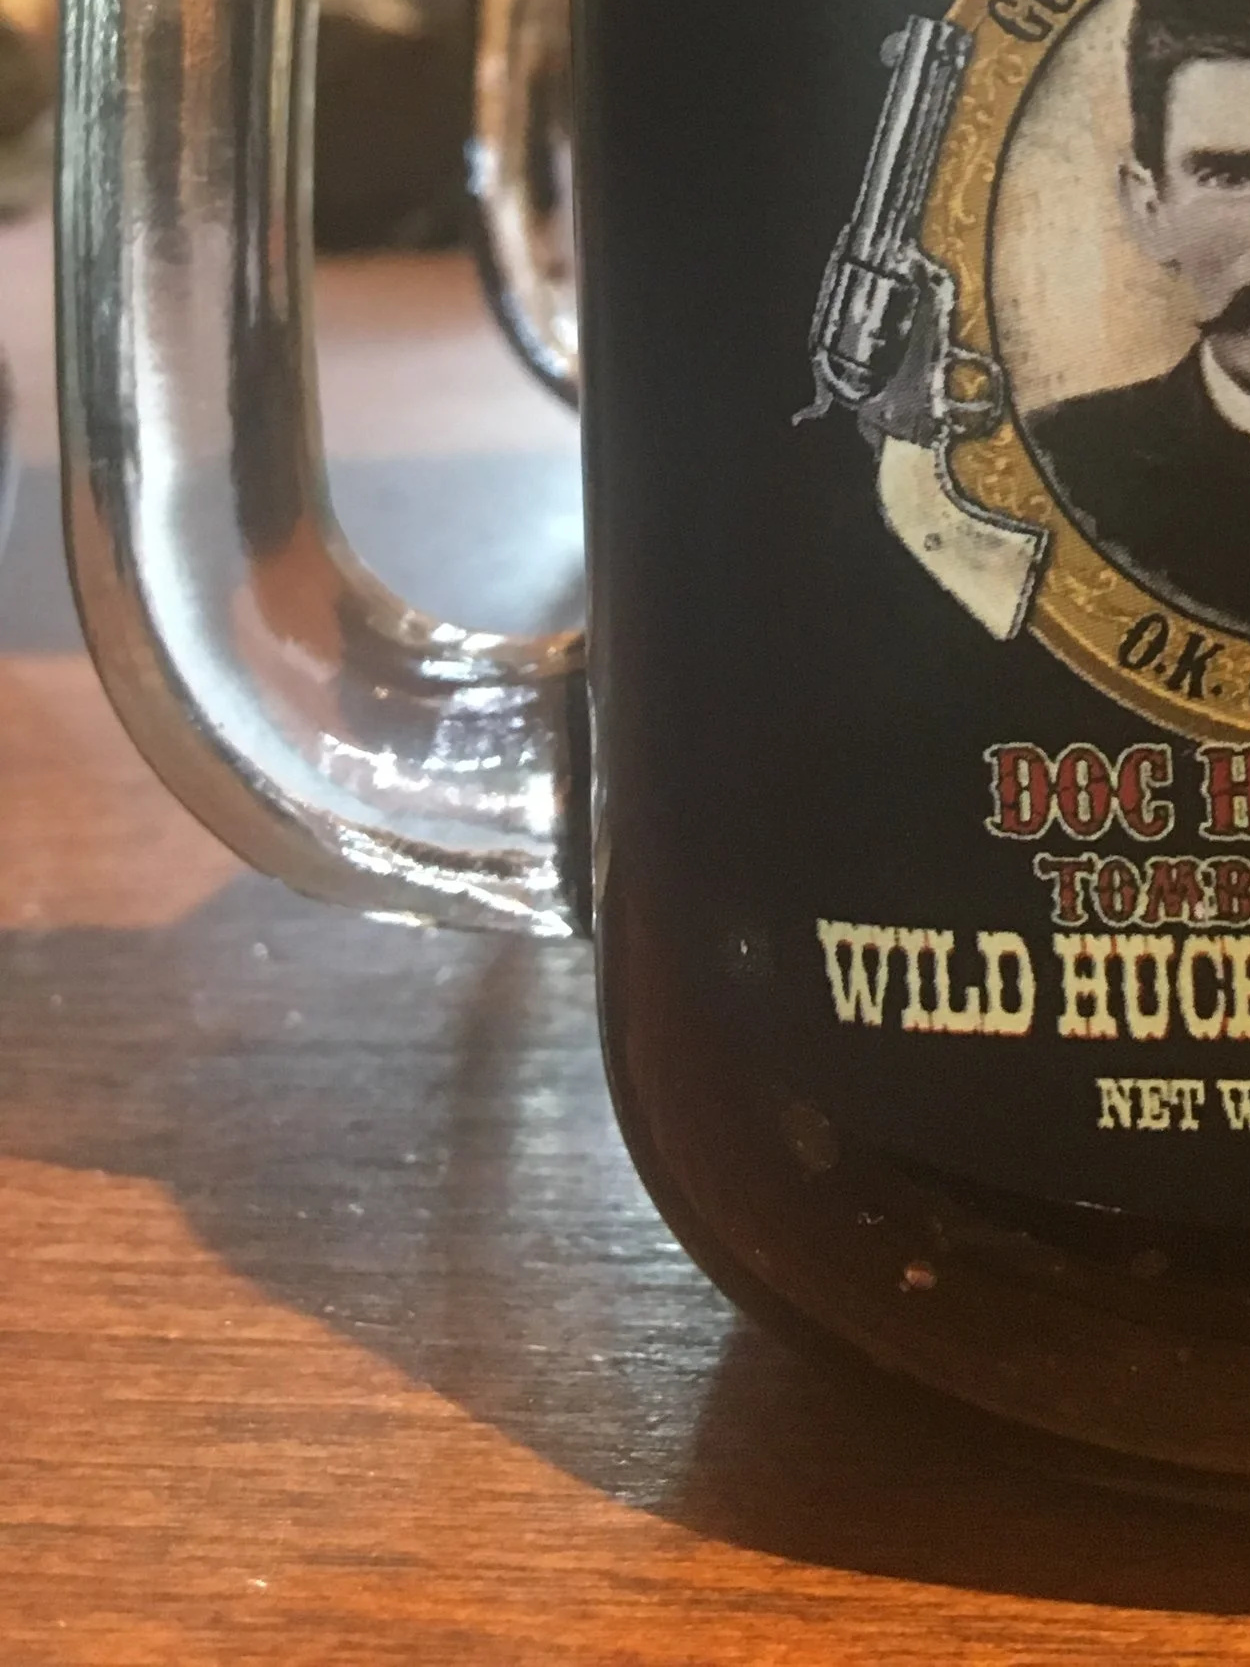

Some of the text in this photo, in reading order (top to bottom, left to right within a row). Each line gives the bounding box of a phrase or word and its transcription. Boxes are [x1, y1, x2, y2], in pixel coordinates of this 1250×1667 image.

[984, 741, 1175, 840] DOC
[815, 918, 1036, 1037] WILD
[1096, 1077, 1205, 1131] NET
